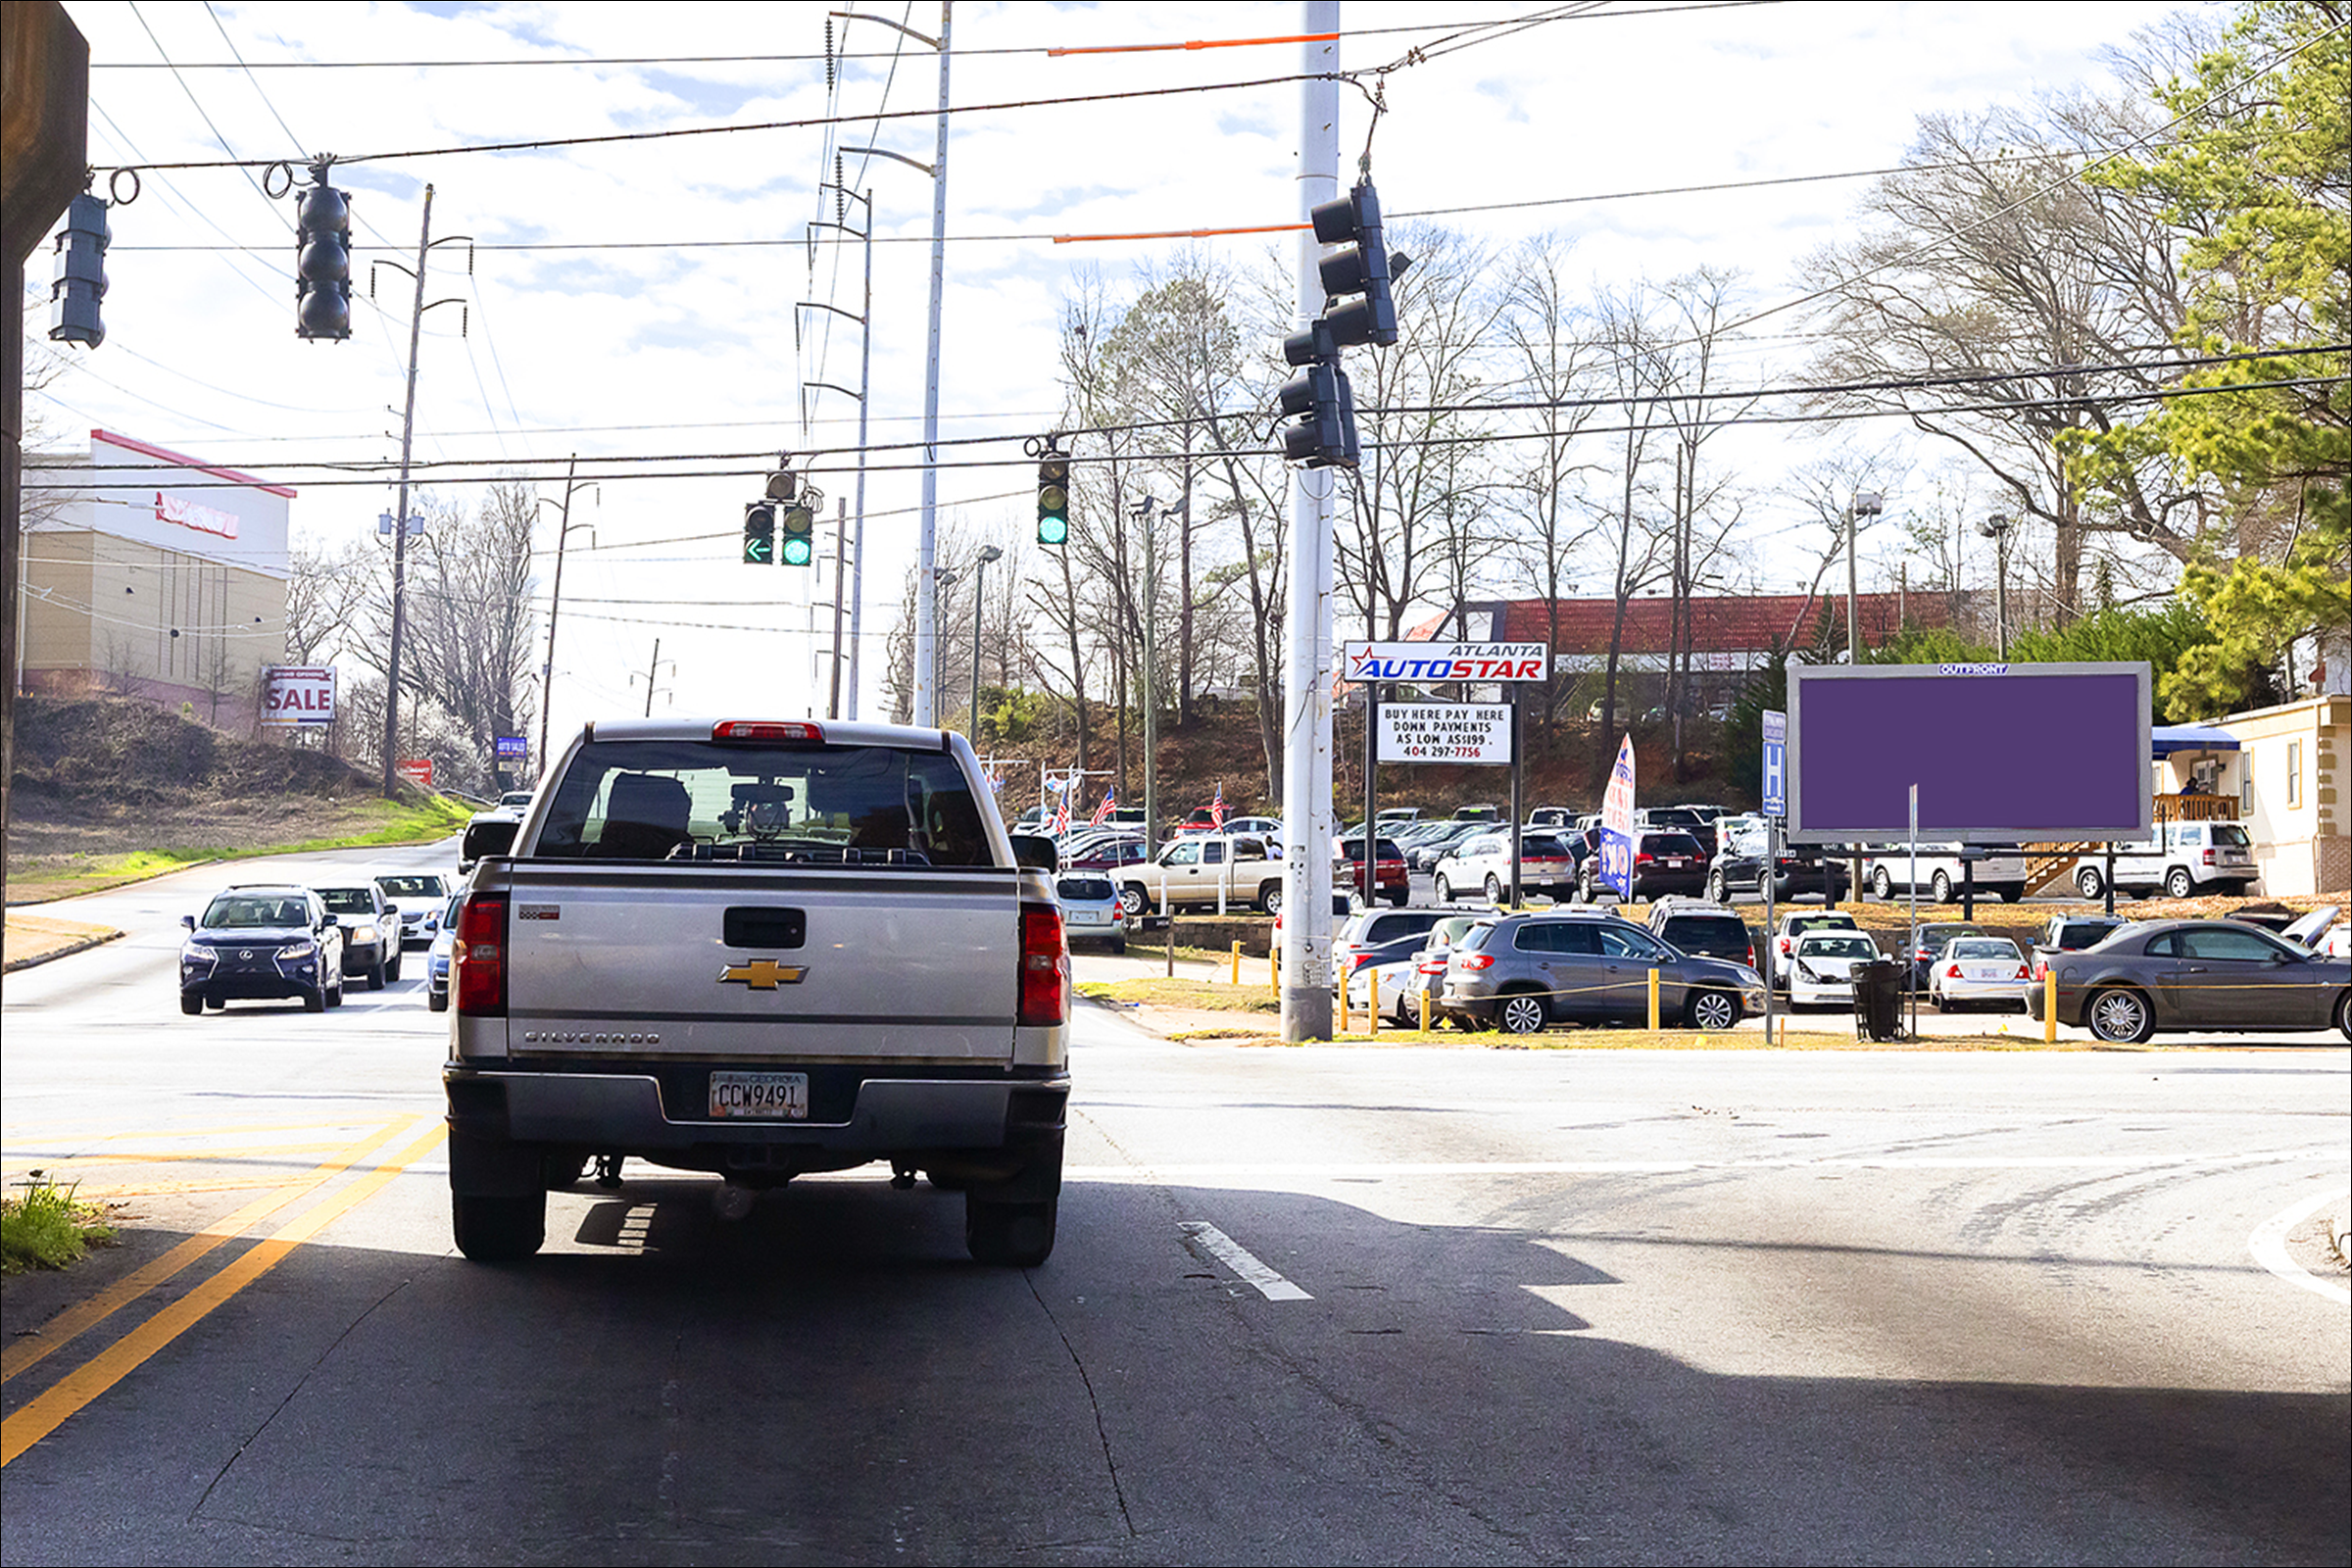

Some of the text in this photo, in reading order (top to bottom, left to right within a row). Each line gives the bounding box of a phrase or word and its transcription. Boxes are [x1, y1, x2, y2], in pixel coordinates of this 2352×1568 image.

[1448, 645, 1543, 657] ATLANTA
[1356, 660, 1543, 678] AUTOSTAR
[1940, 664, 2009, 674] OUTFRONT
[267, 689, 330, 710] SALE
[1385, 710, 1504, 720] BUY HERE PAY HERE
[1394, 721, 1492, 732] DOWN PAYMENTS
[1396, 734, 1411, 744] AS
[1417, 734, 1440, 744] LOW
[1403, 746, 1481, 758] 404 297-7756
[1766, 745, 1783, 797] H
[524, 1031, 661, 1044] SILVERADO
[749, 1074, 802, 1084] GEORGIA
[718, 1084, 797, 1108] CCW9491
